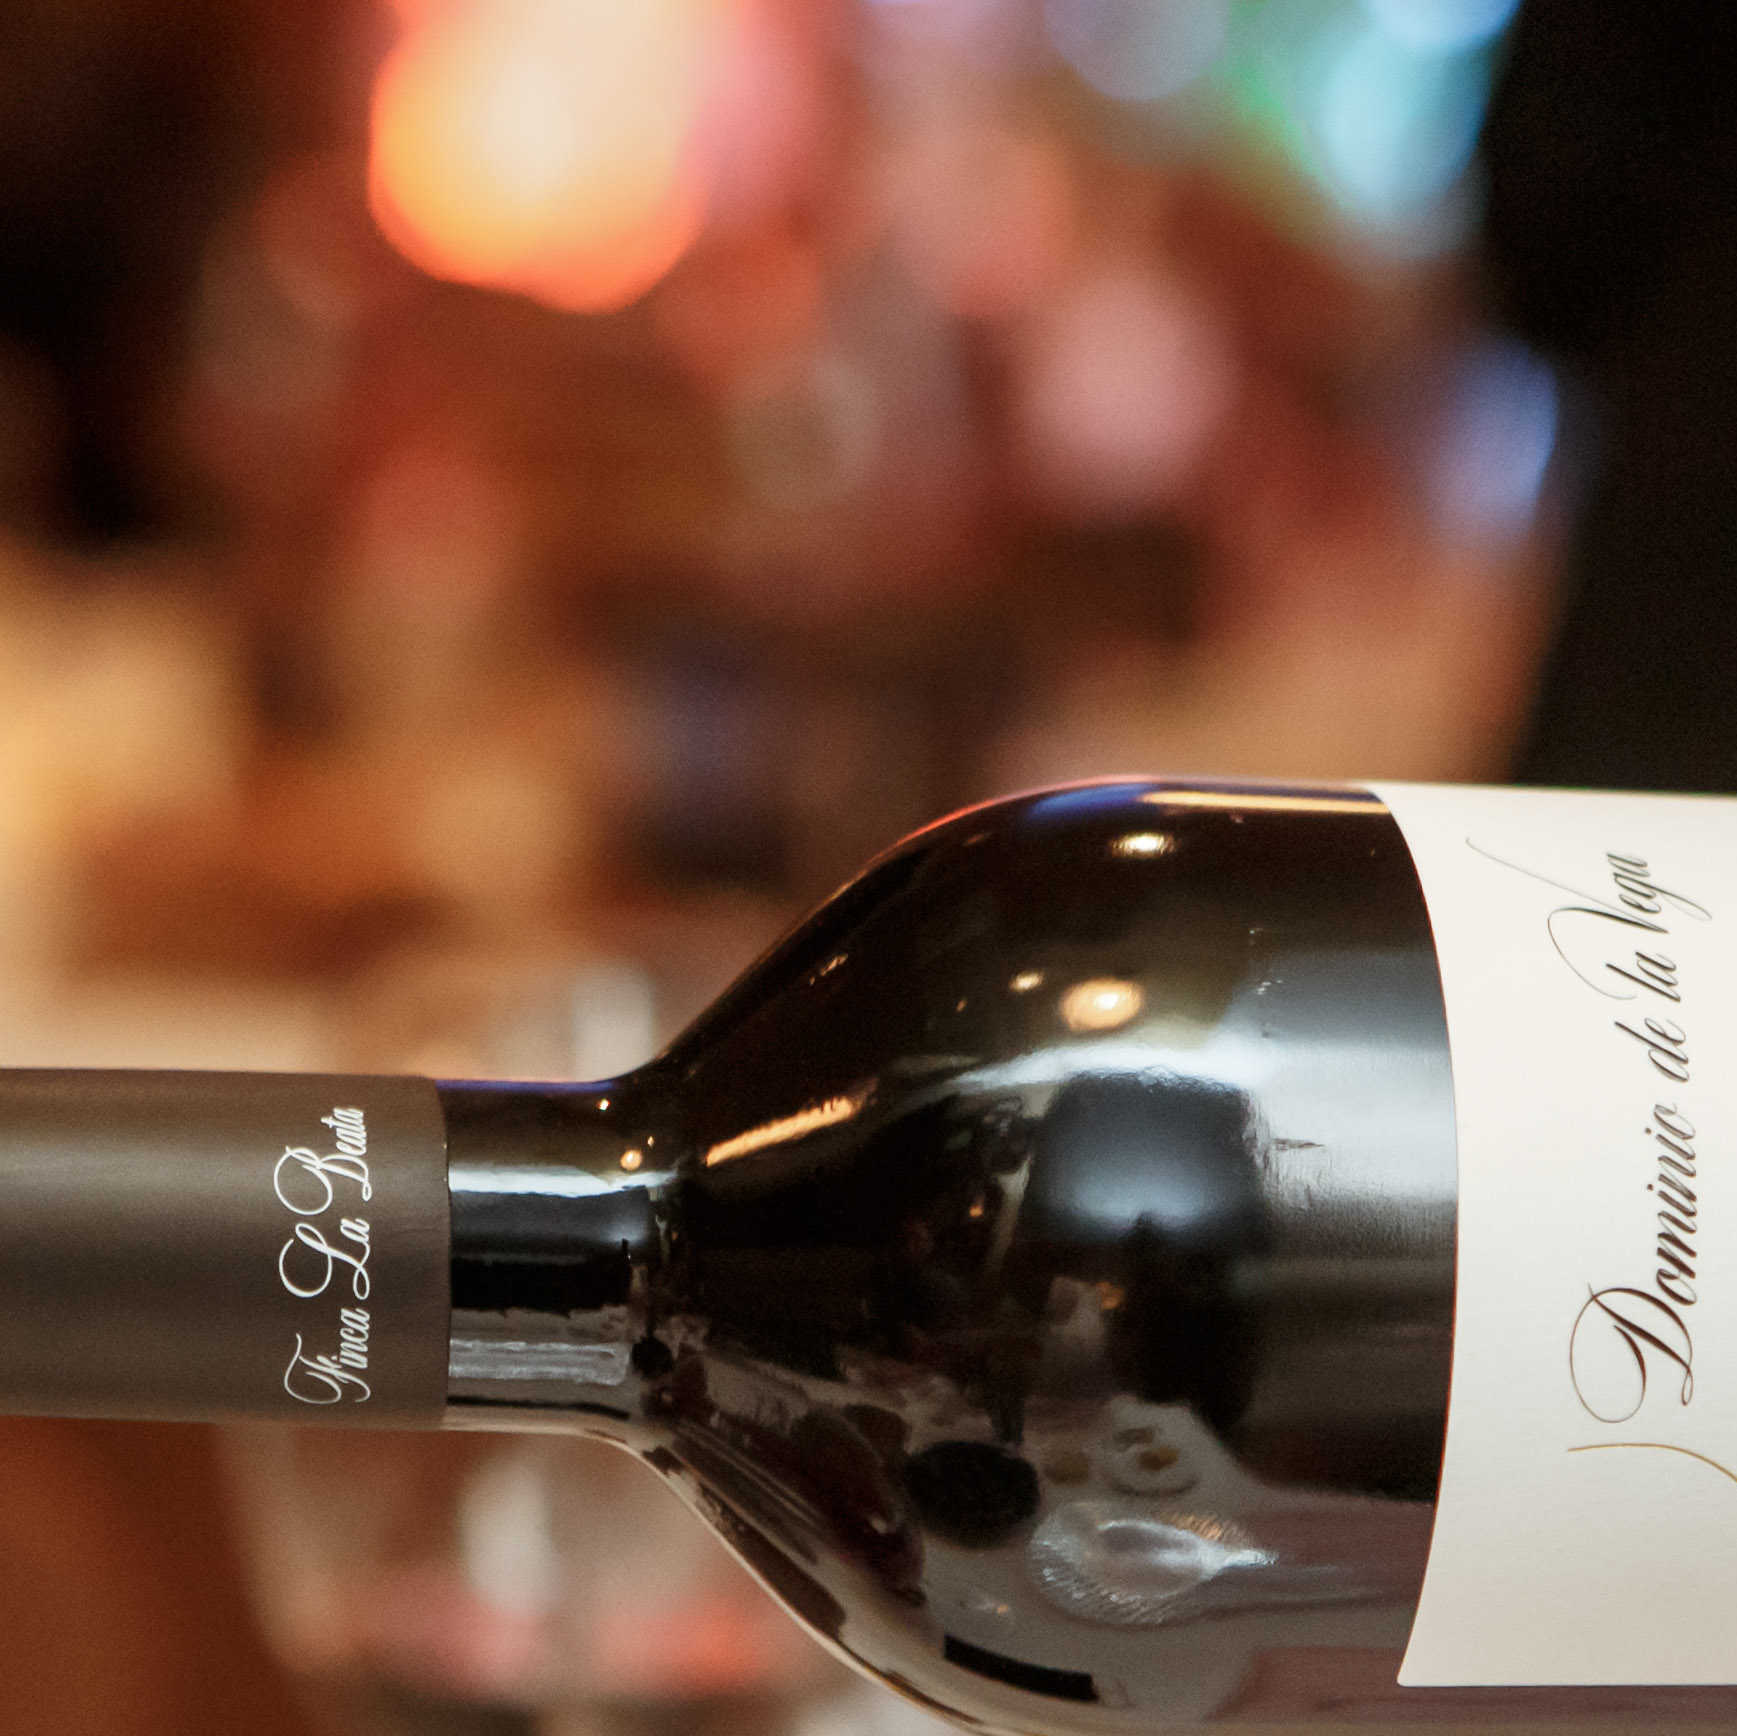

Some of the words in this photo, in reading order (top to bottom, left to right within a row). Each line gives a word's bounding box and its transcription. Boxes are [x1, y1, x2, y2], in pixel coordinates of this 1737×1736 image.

[1465, 837, 1711, 998] Vega
[1606, 950, 1680, 1001] la
[1614, 1016, 1689, 1082] de
[273, 1106, 372, 1214] Beata
[279, 1216, 371, 1299] La
[1570, 1103, 1696, 1422] Dominio
[284, 1307, 371, 1403] Finca
